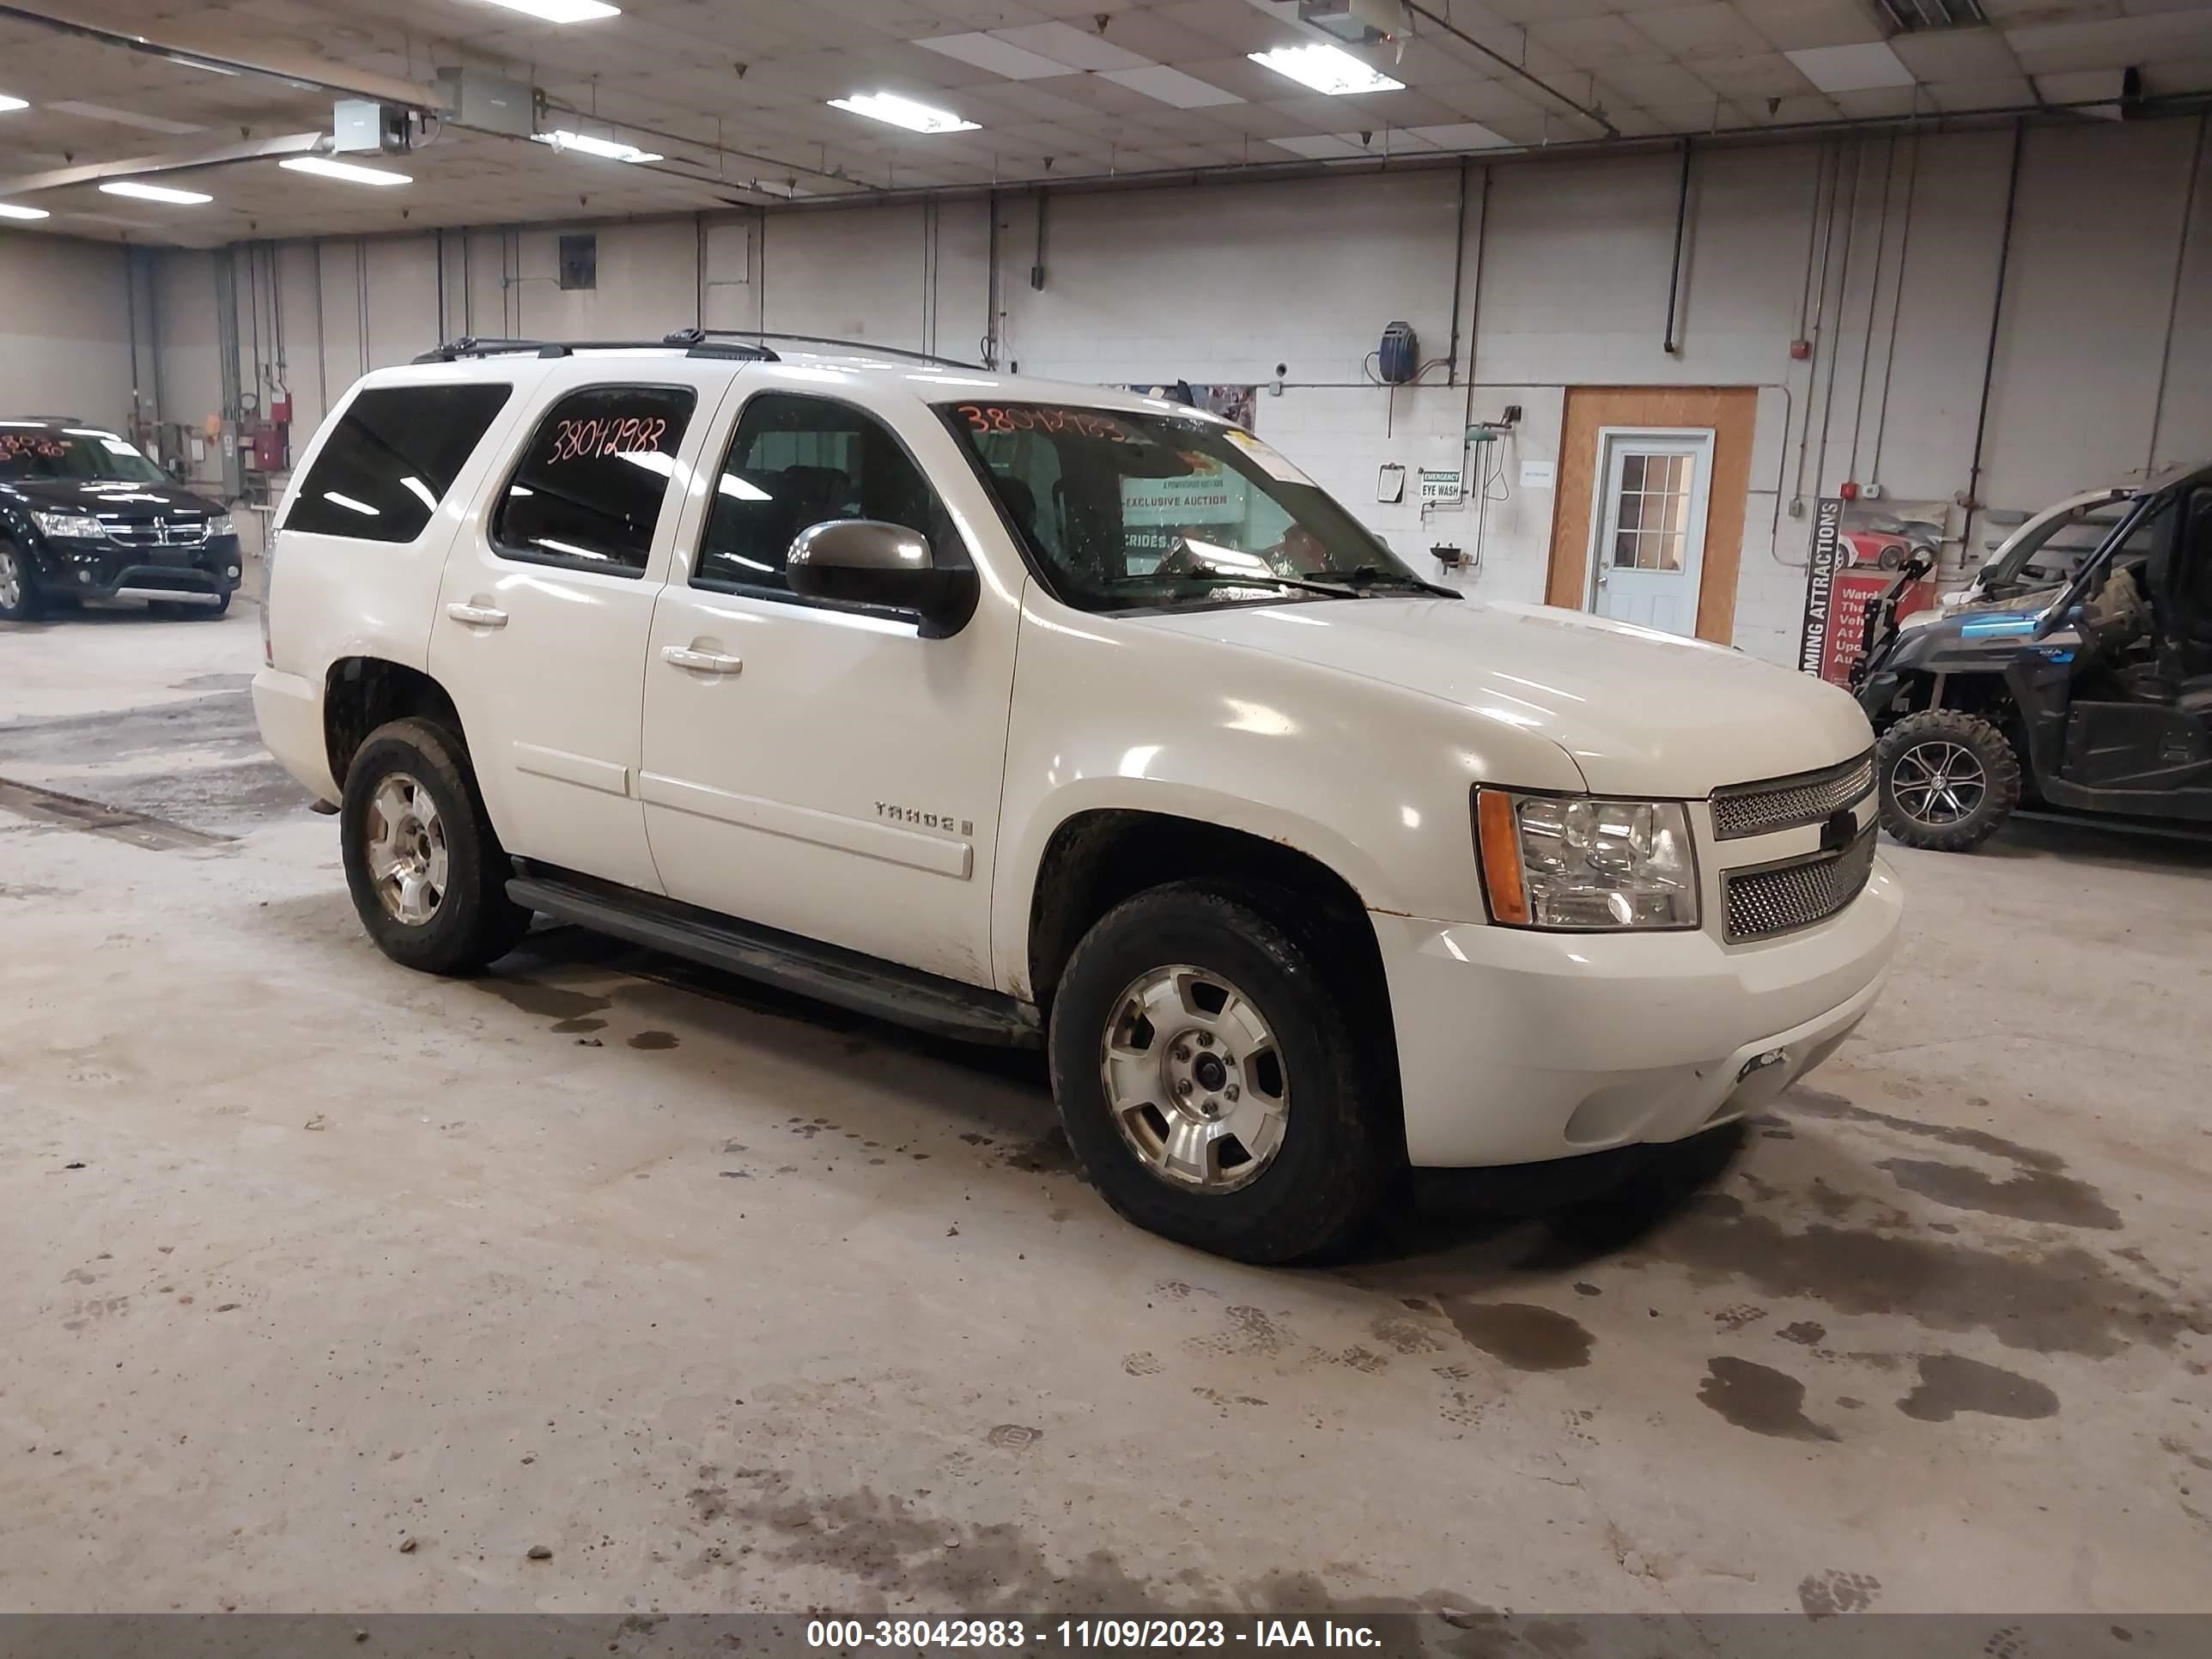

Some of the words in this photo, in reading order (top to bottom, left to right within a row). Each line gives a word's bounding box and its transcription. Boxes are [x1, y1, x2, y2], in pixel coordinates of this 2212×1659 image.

[547, 416, 666, 465] 38042983
[1183, 495, 1227, 506] AUCTION
[1422, 485, 1437, 495] EYE
[1437, 485, 1459, 496] WASH
[1809, 502, 1838, 620] ATTRACTIONS
[1838, 628, 1855, 639] At
[874, 800, 955, 832] TAHOE
